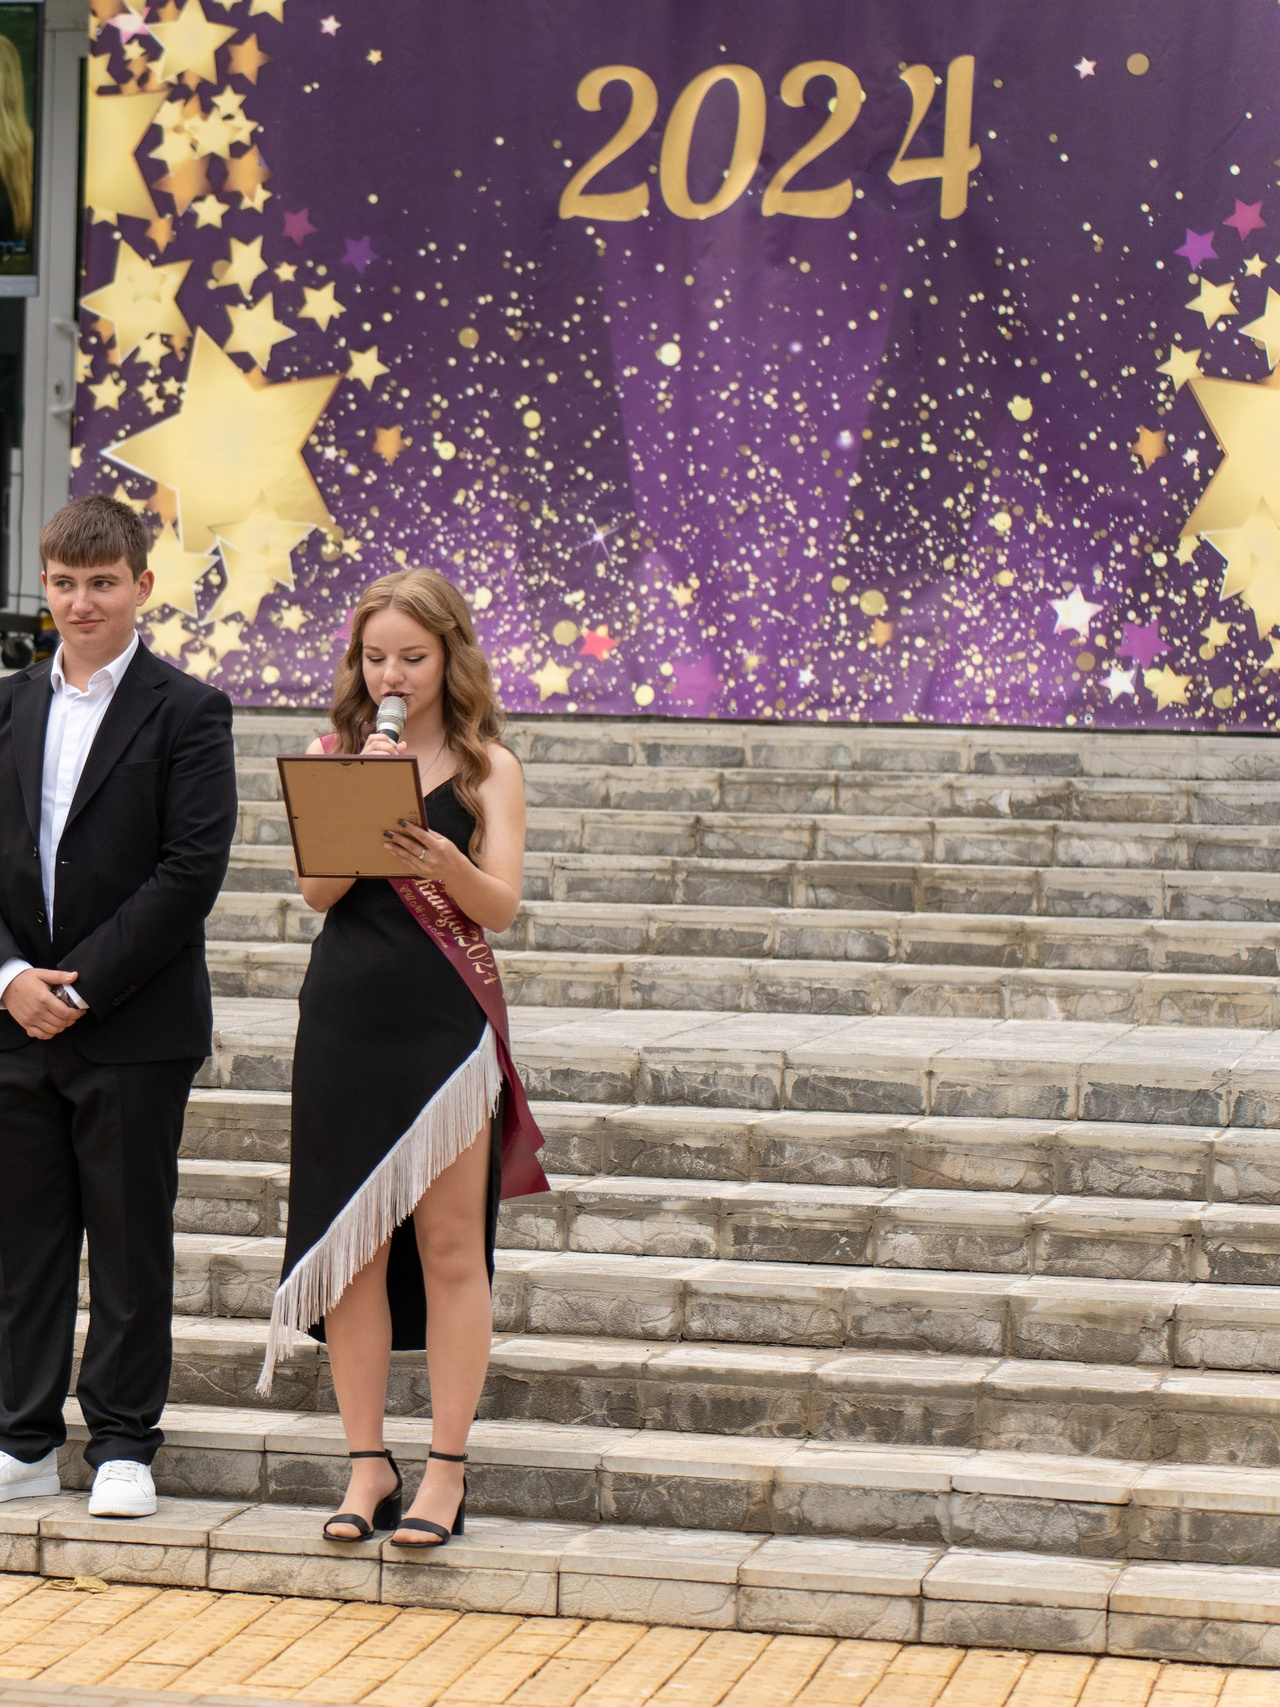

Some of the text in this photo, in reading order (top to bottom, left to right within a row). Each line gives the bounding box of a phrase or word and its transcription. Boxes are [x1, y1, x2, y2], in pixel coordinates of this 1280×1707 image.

[559, 55, 982, 222] 2024
[412, 878, 466, 936] кница
[454, 930, 499, 985] 2024
